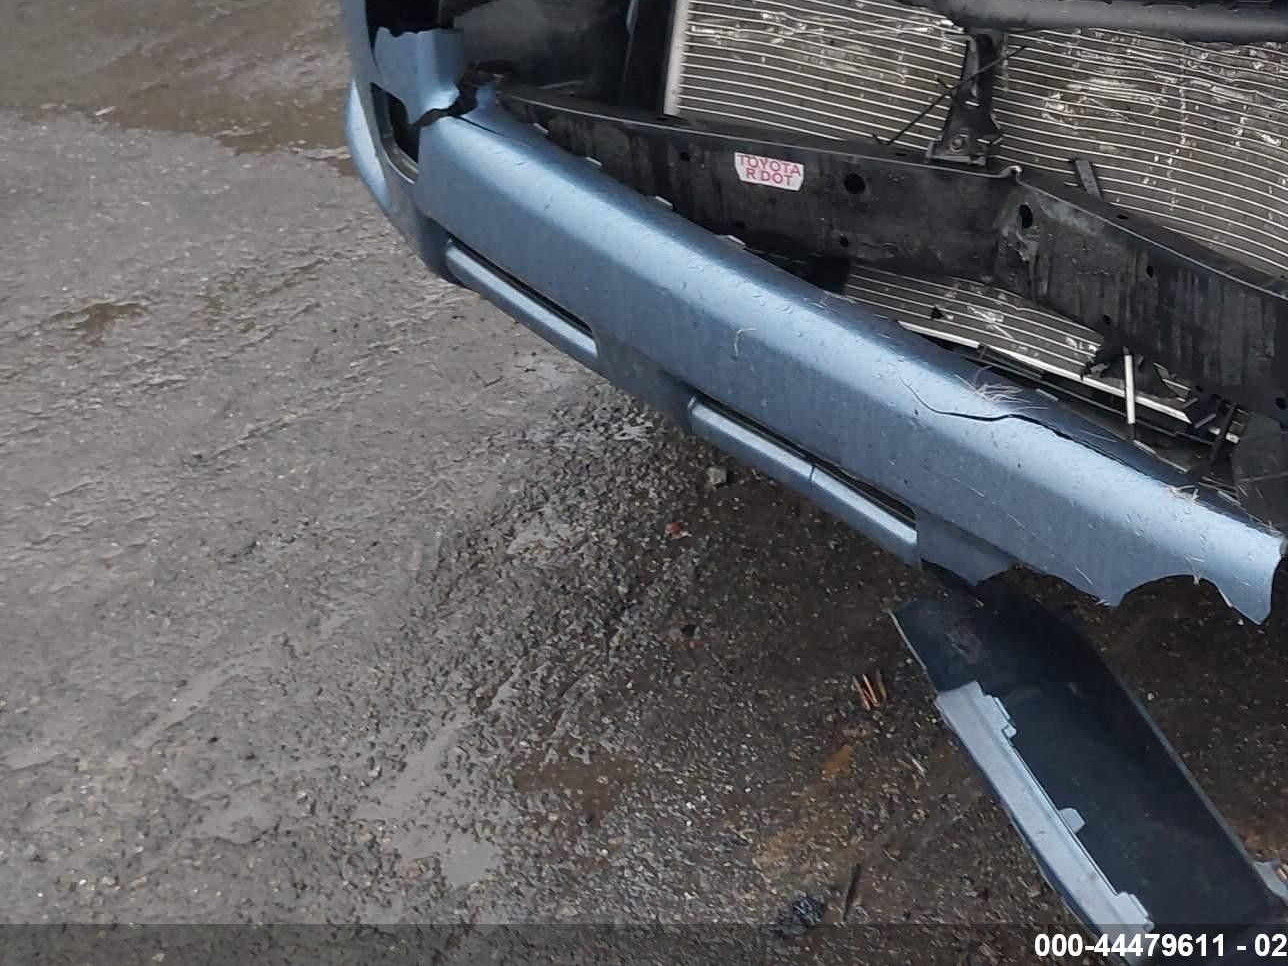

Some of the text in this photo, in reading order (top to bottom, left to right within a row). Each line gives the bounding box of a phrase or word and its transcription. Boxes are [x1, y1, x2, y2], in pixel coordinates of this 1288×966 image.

[737, 154, 801, 176] TOYOTA
[745, 167, 794, 187] R DOT
